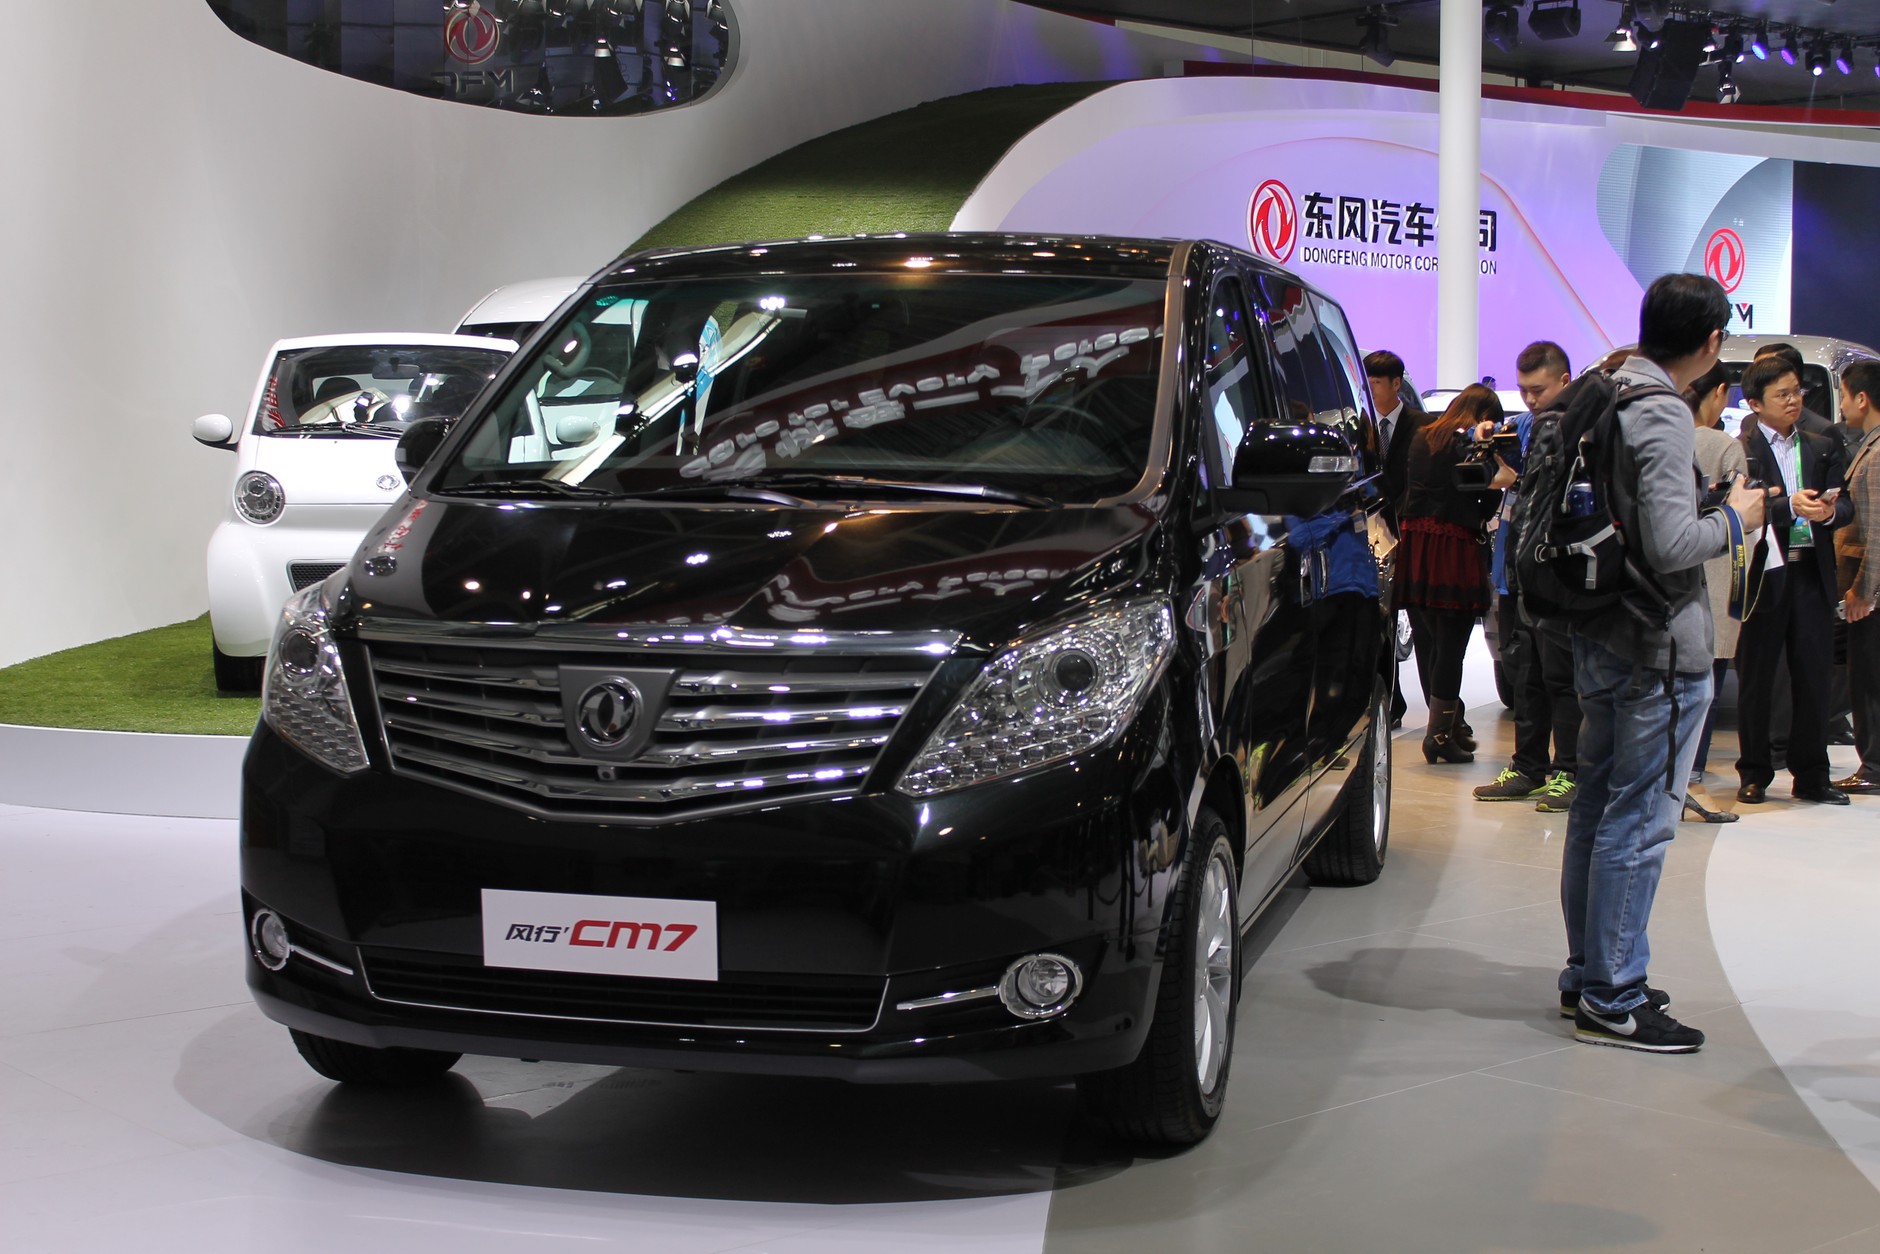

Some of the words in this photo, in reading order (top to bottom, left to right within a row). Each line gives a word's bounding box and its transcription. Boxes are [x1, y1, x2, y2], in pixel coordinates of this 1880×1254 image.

[431, 68, 514, 96] DFM
[1303, 192, 1497, 252] 东风汽车司
[1303, 247, 1367, 267] DONGFENG
[1370, 252, 1412, 271] MOTOR
